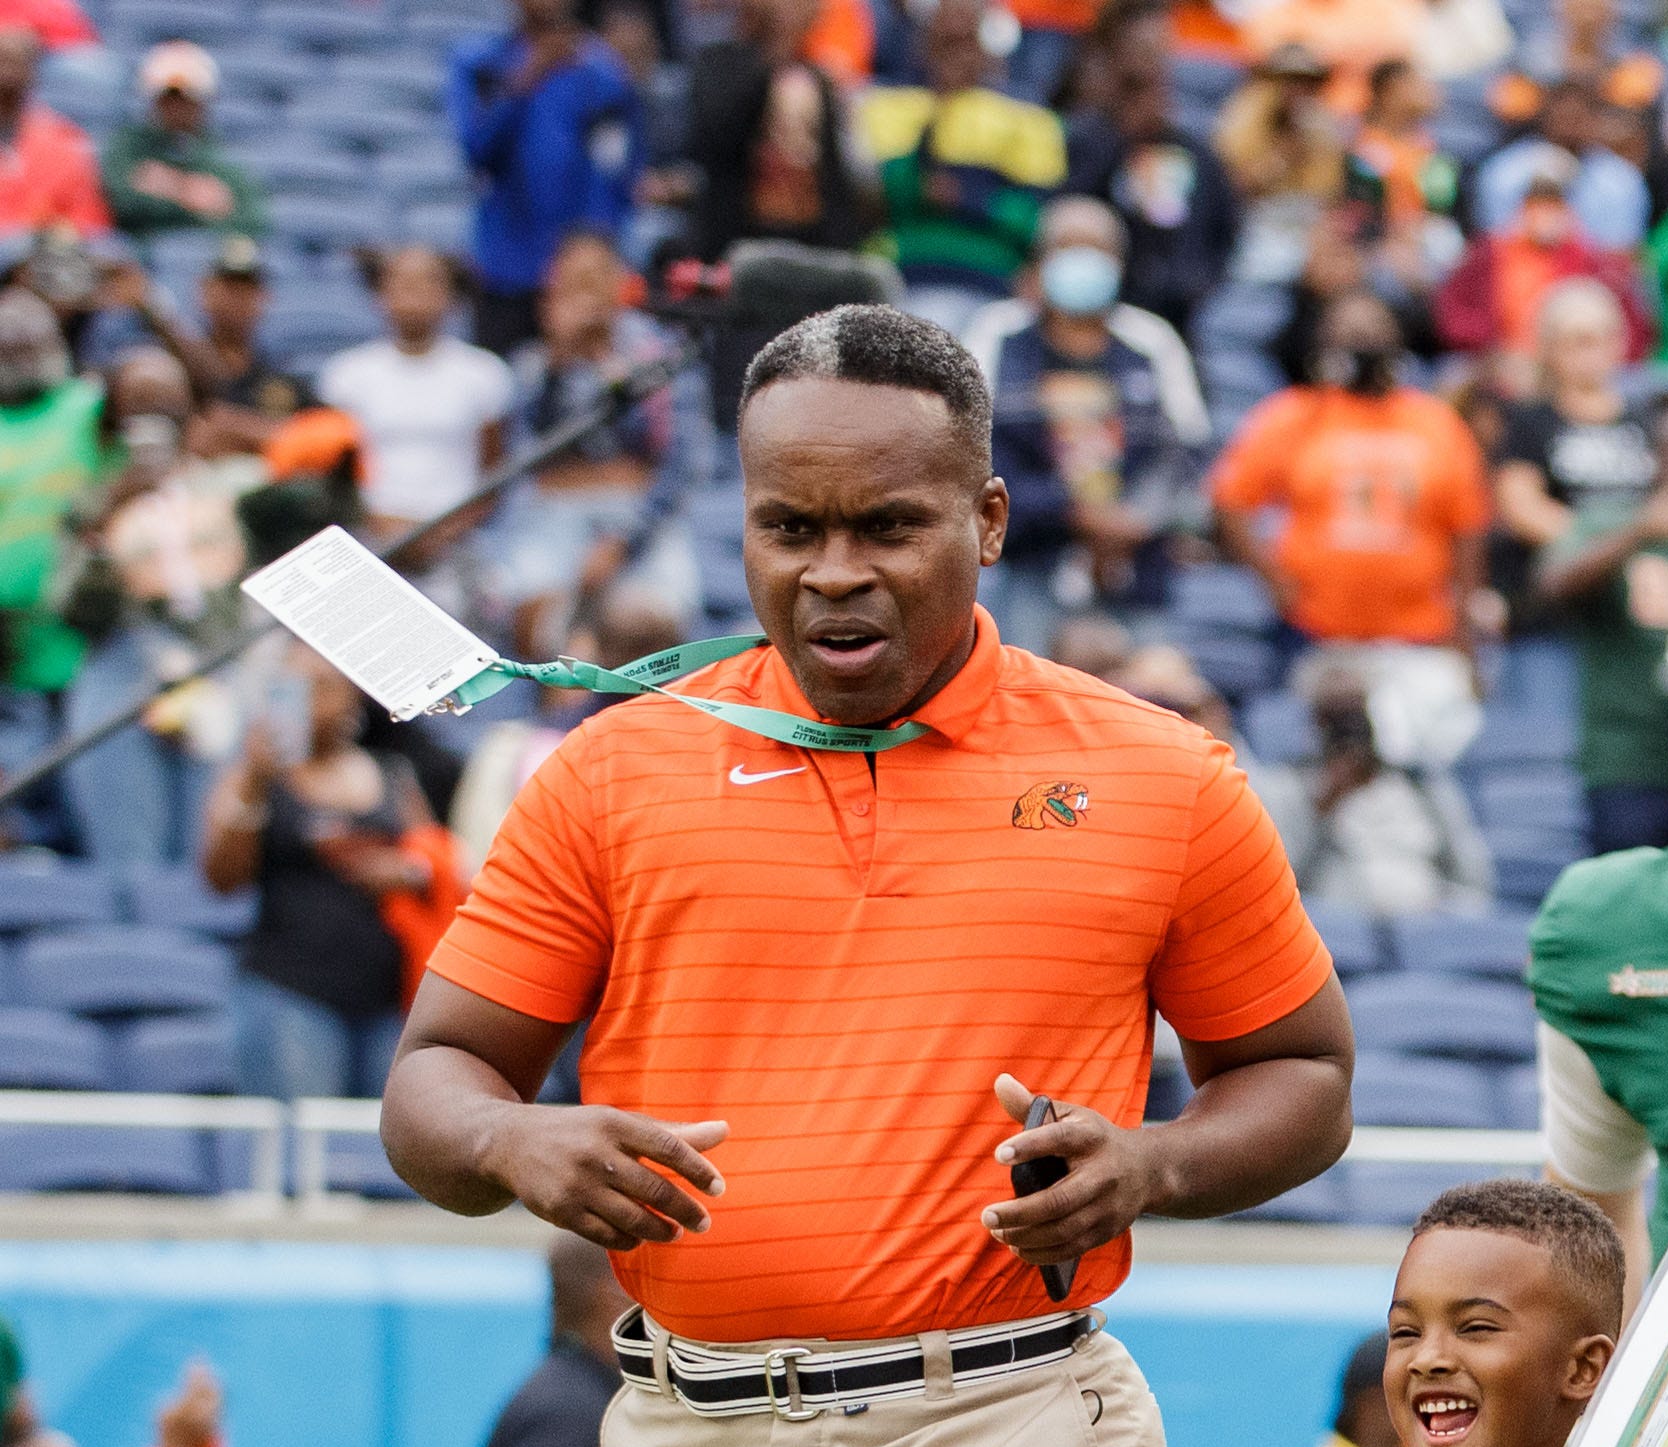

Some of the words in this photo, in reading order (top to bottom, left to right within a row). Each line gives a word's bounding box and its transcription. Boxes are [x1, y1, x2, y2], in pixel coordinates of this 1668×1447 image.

[648, 653, 681, 671] CITRUS
[791, 731, 828, 746] CITRUS
[828, 738, 872, 748] SPORTS
[796, 724, 827, 738] FLORIDA
